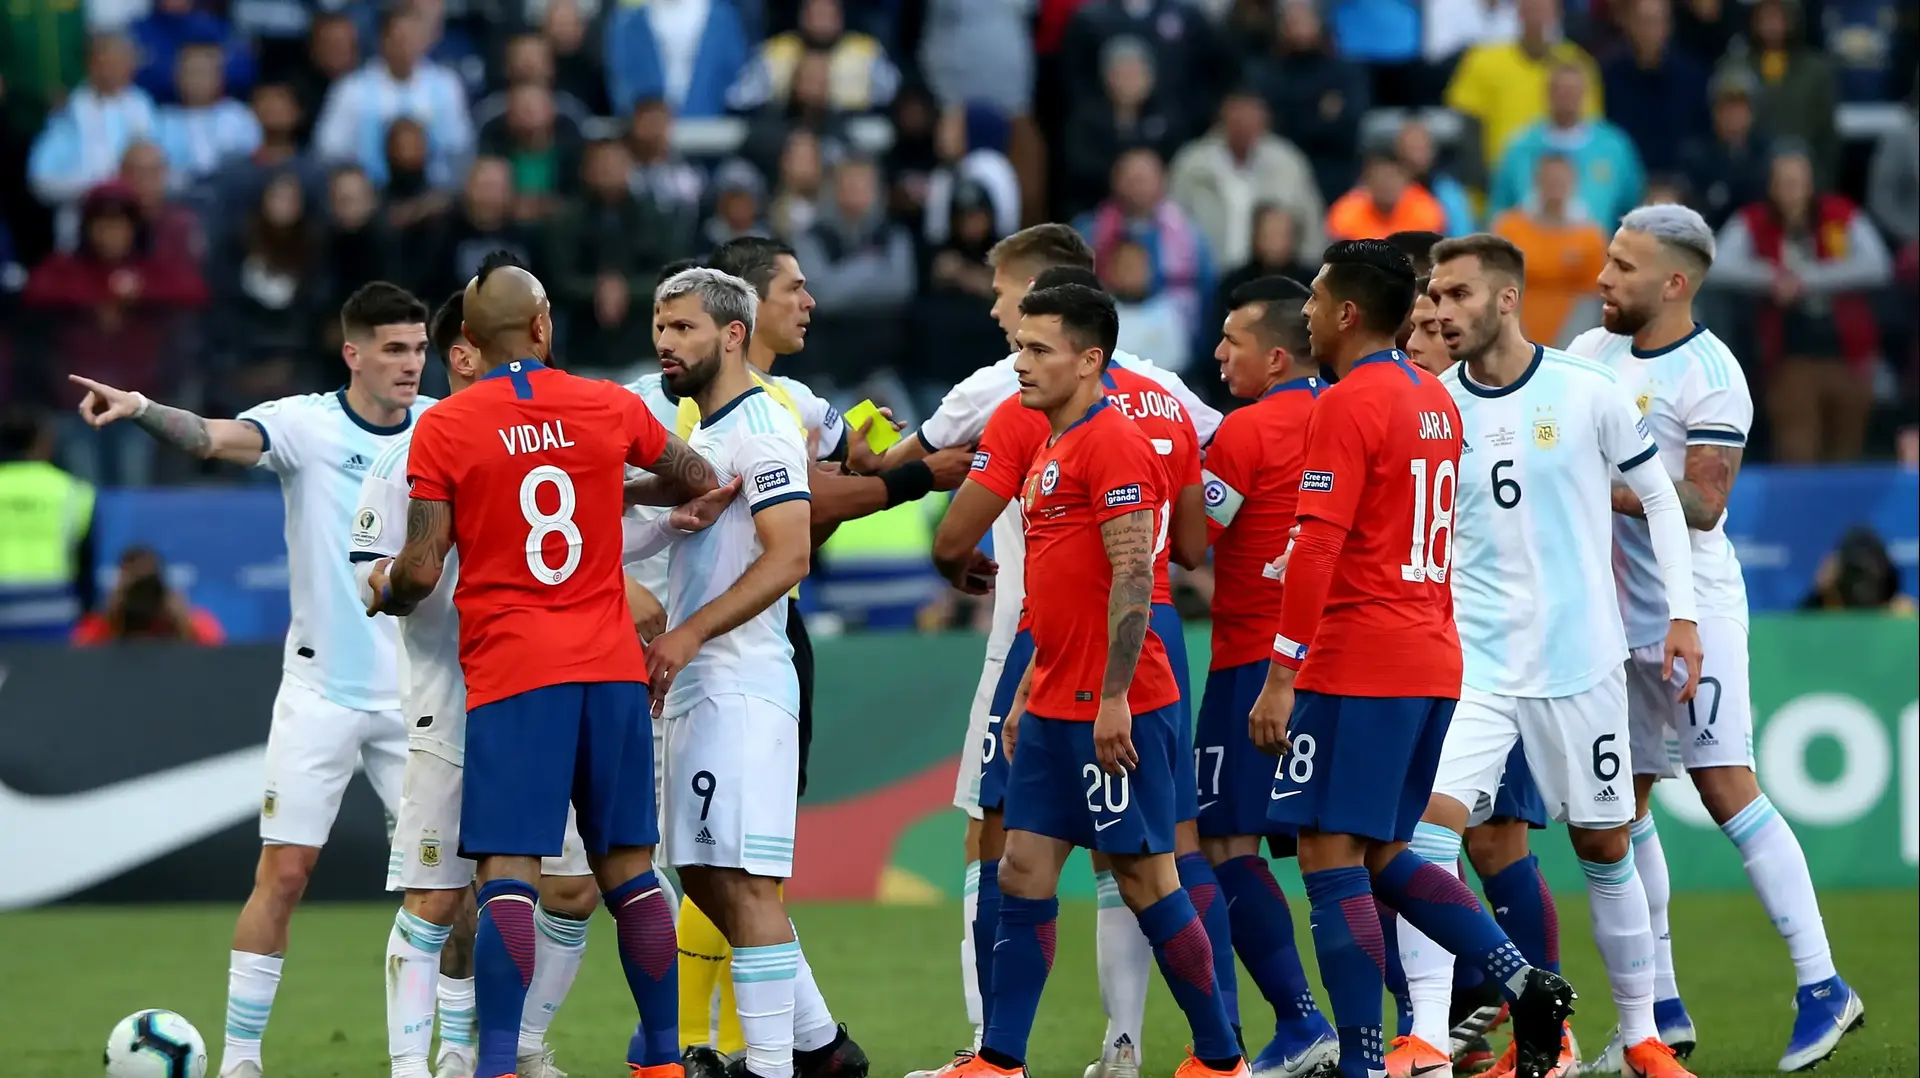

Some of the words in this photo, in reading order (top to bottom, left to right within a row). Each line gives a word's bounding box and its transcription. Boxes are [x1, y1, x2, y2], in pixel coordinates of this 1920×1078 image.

[498, 420, 575, 456] VIDAL
[1418, 411, 1453, 440] JARA
[1538, 425, 1555, 441] AFA
[756, 473, 775, 484] Cree
[775, 470, 787, 478] en
[758, 477, 786, 492] grande
[1303, 480, 1329, 489] grande
[1304, 473, 1321, 481] Cree
[1491, 459, 1522, 509] 6
[1107, 493, 1136, 505] grande
[519, 465, 583, 586] 8
[1401, 458, 1456, 584] 18
[1682, 676, 1722, 727] 17
[1592, 733, 1620, 782] 6
[691, 770, 717, 821] 9
[1082, 763, 1129, 813] 20
[694, 837, 717, 846] adidas
